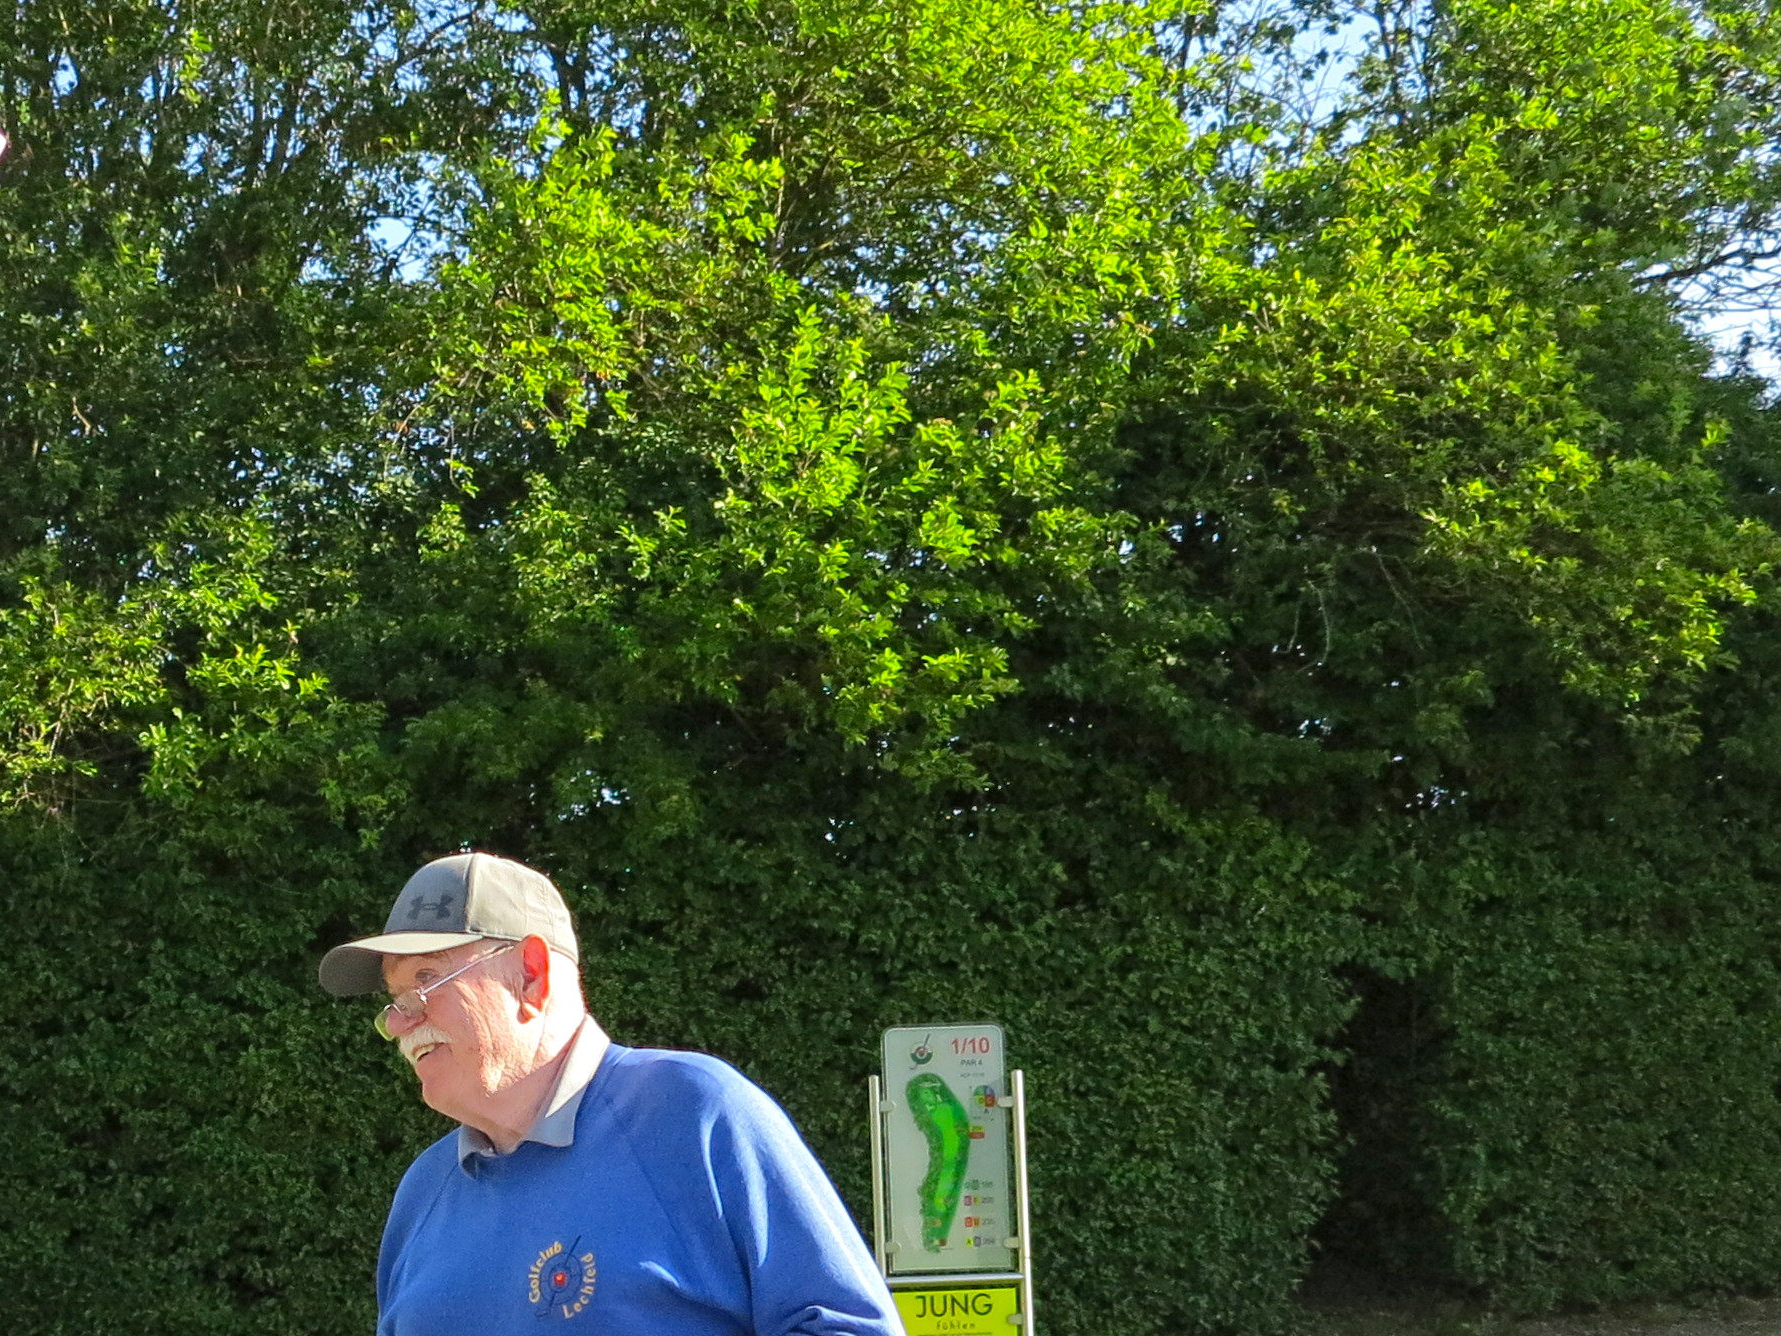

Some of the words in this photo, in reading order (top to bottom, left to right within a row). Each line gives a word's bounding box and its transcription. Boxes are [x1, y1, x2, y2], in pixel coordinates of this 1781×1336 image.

[951, 1036, 990, 1054] 1/10
[528, 1240, 562, 1303] Golfclub
[915, 1293, 993, 1318] JUNG
